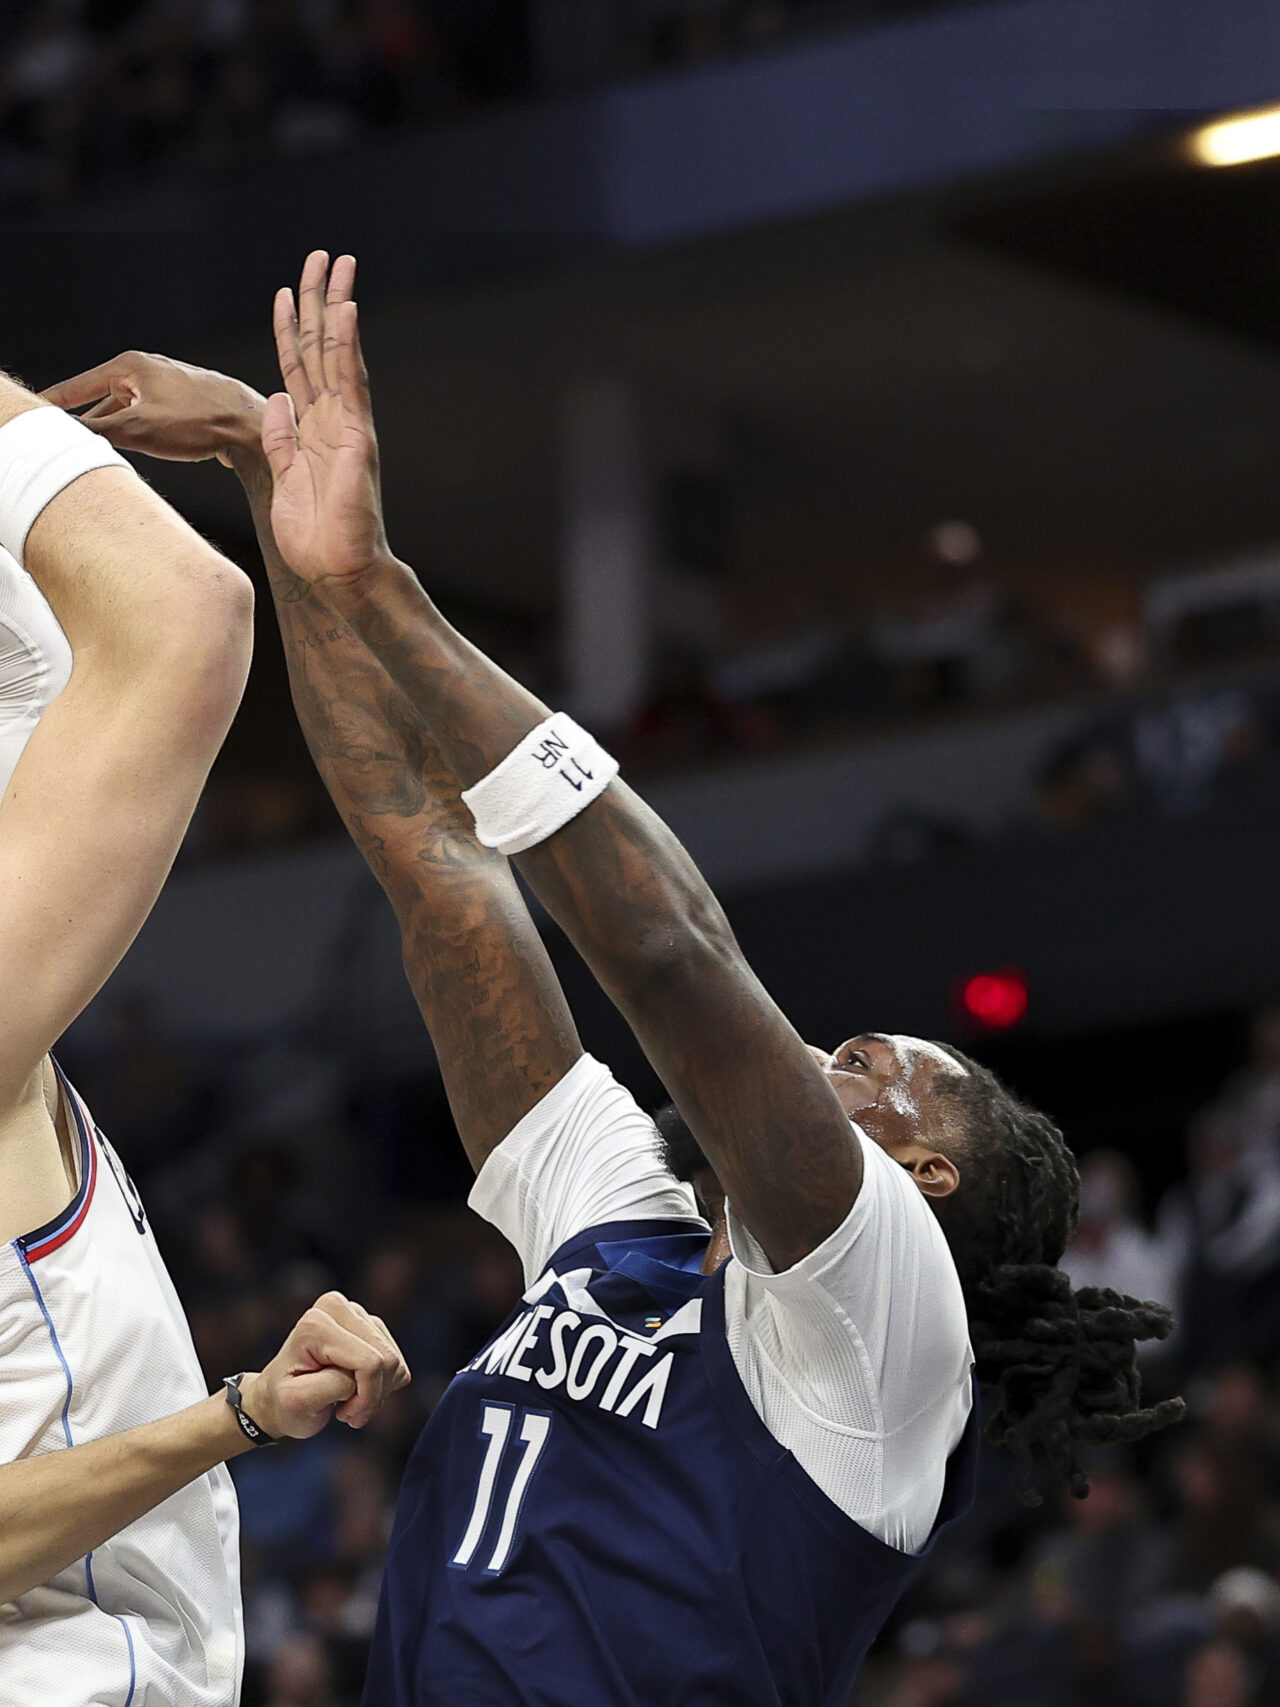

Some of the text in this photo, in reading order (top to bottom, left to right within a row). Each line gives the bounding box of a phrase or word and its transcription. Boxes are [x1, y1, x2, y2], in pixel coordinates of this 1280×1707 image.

[530, 729, 570, 770] NR
[558, 757, 594, 792] 11
[451, 1404, 552, 1572] 11
